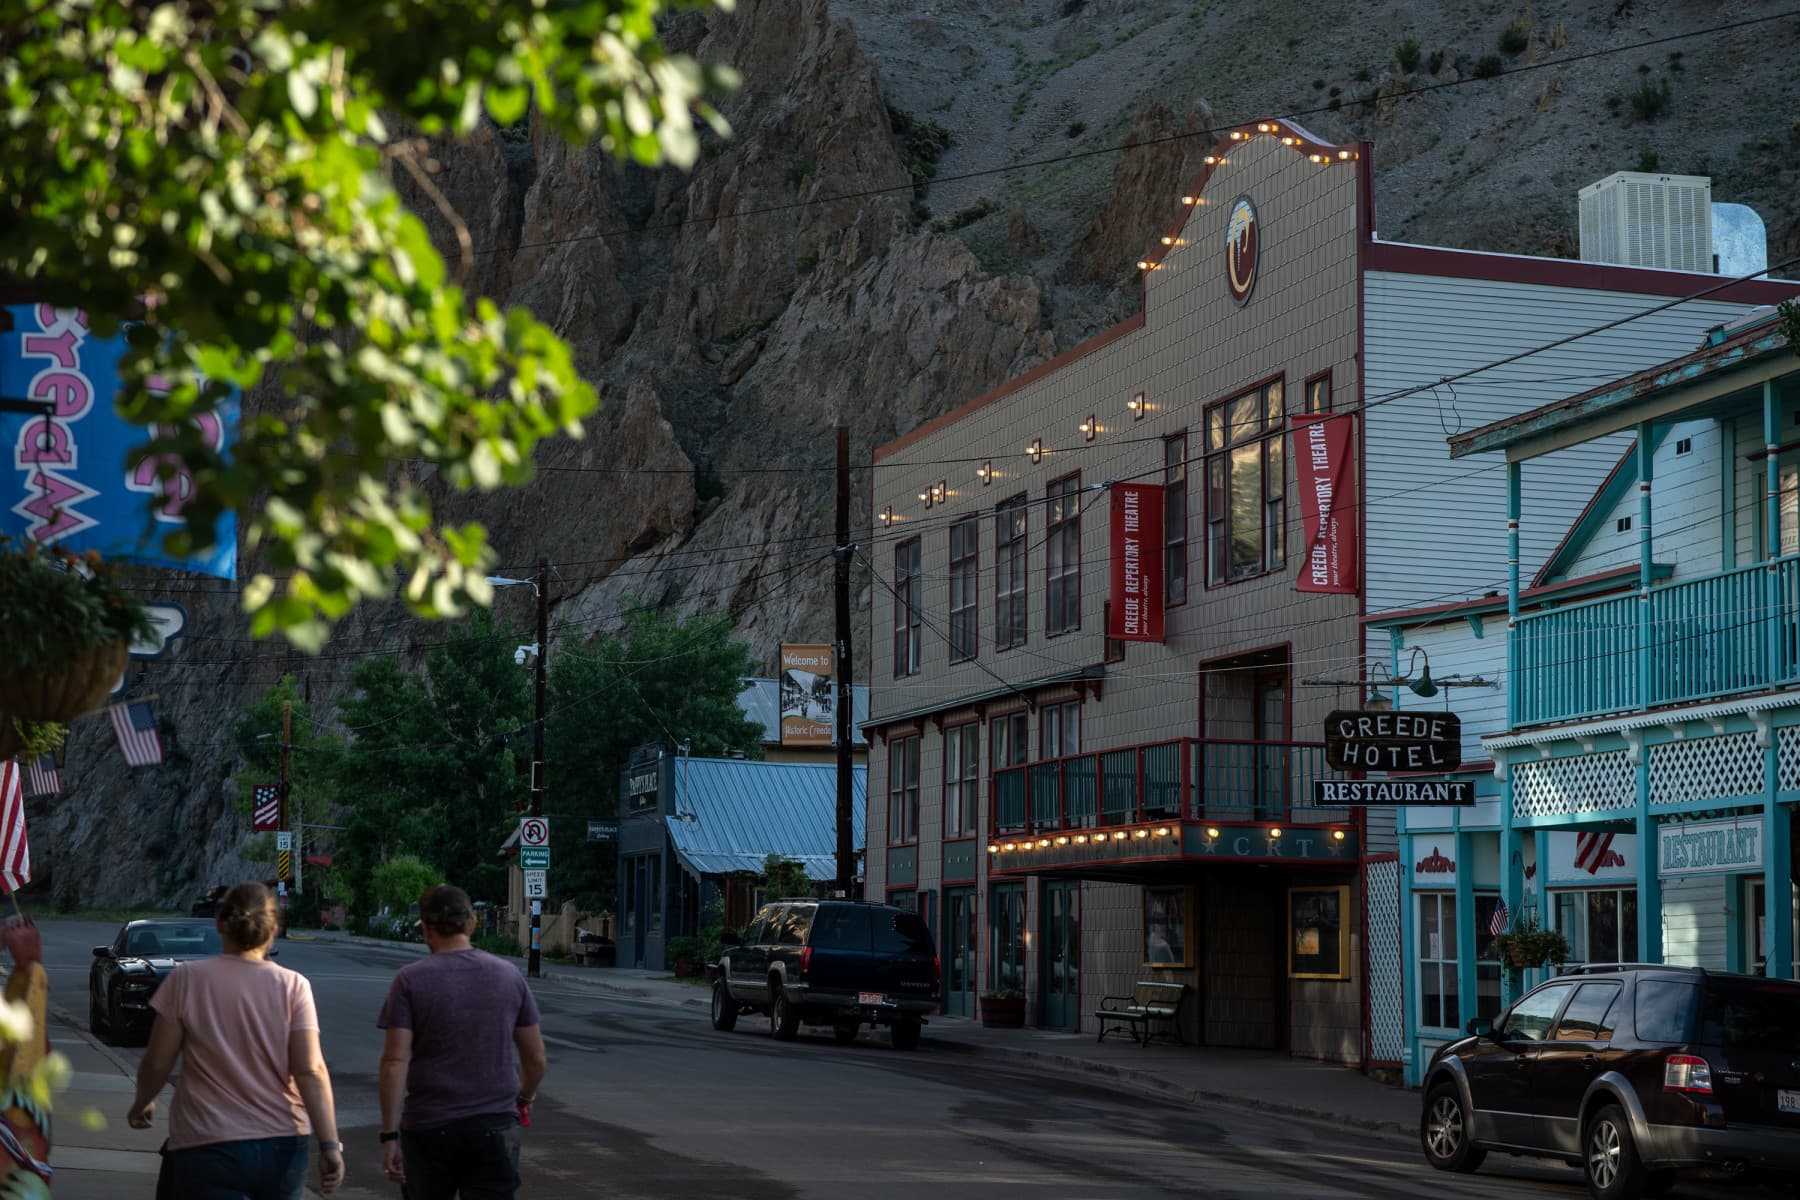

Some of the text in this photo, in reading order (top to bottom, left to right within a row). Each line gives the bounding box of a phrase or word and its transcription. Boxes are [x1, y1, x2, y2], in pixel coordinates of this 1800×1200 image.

[1308, 422, 1333, 585] CREEDE REPERTORY THEATRE
[1330, 517, 1339, 542] always
[1124, 490, 1139, 635] CREEDE REPERTORY THEATRE
[1332, 570, 1340, 586] your
[783, 653, 829, 666] Welcome to
[784, 724, 808, 737] Historic
[1339, 715, 1446, 741] CREEDE
[1343, 742, 1444, 768] HOTEL
[1322, 783, 1466, 801] RESTAURANT
[522, 850, 549, 858] PARKING
[1663, 827, 1758, 869] RESTAURANT
[529, 884, 542, 895] 15
